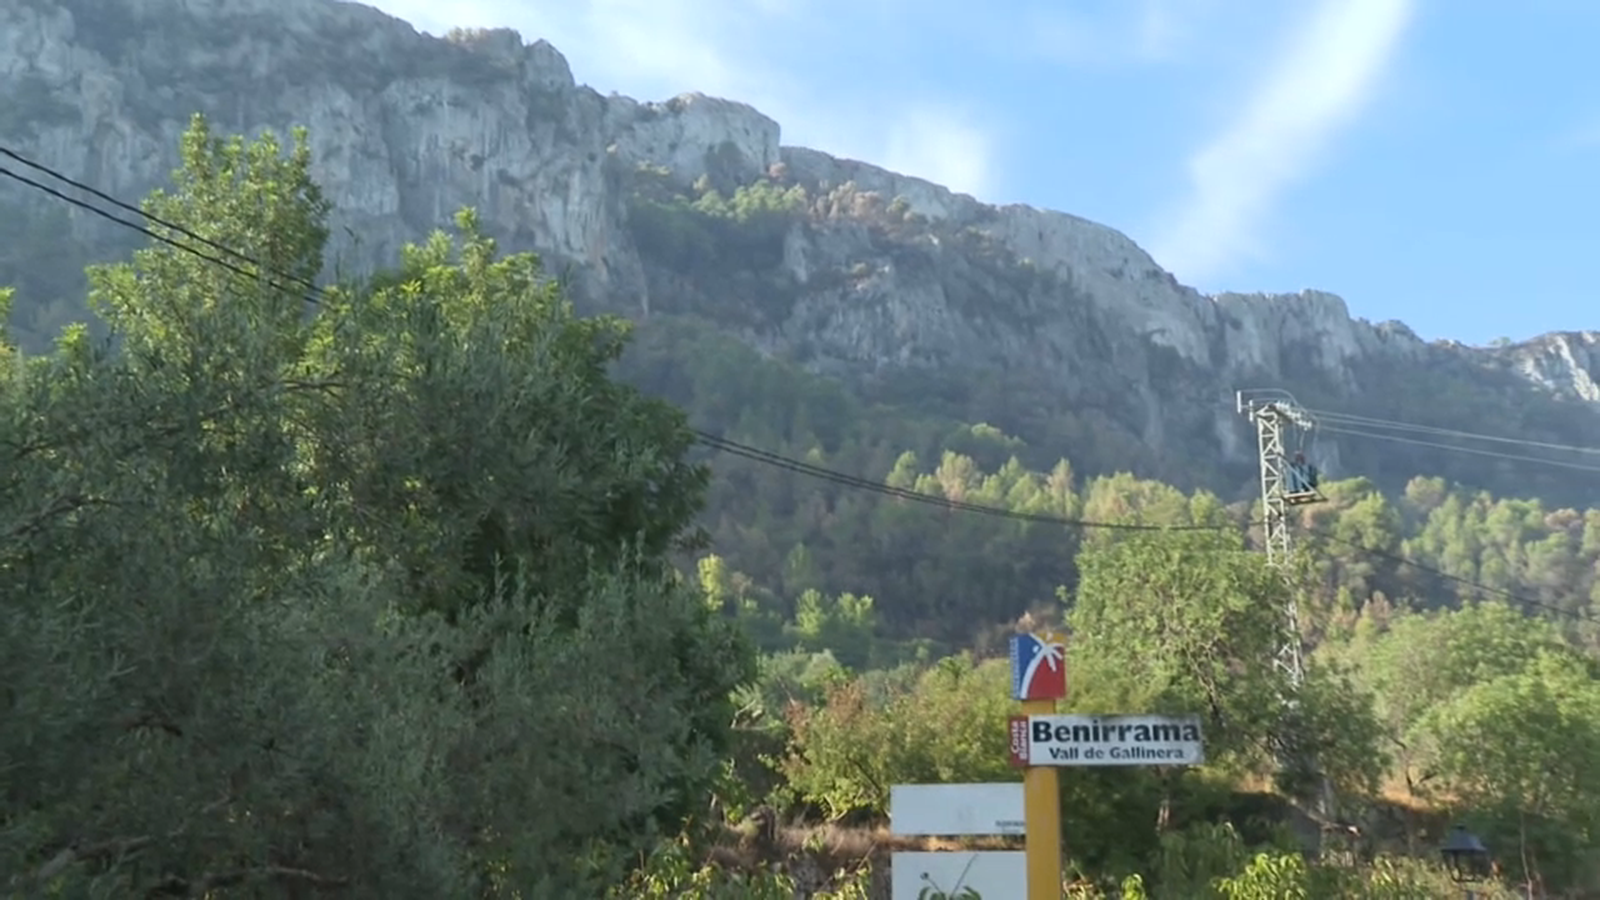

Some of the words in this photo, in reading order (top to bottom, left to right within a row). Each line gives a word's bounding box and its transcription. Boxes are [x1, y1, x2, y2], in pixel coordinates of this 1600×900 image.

[1010, 721, 1020, 754] Costa
[1019, 721, 1028, 760] Blanca
[1032, 720, 1200, 743] Benirrama
[1049, 747, 1079, 760] Vall
[1084, 747, 1104, 760] de
[1109, 746, 1184, 760] Gallinera
